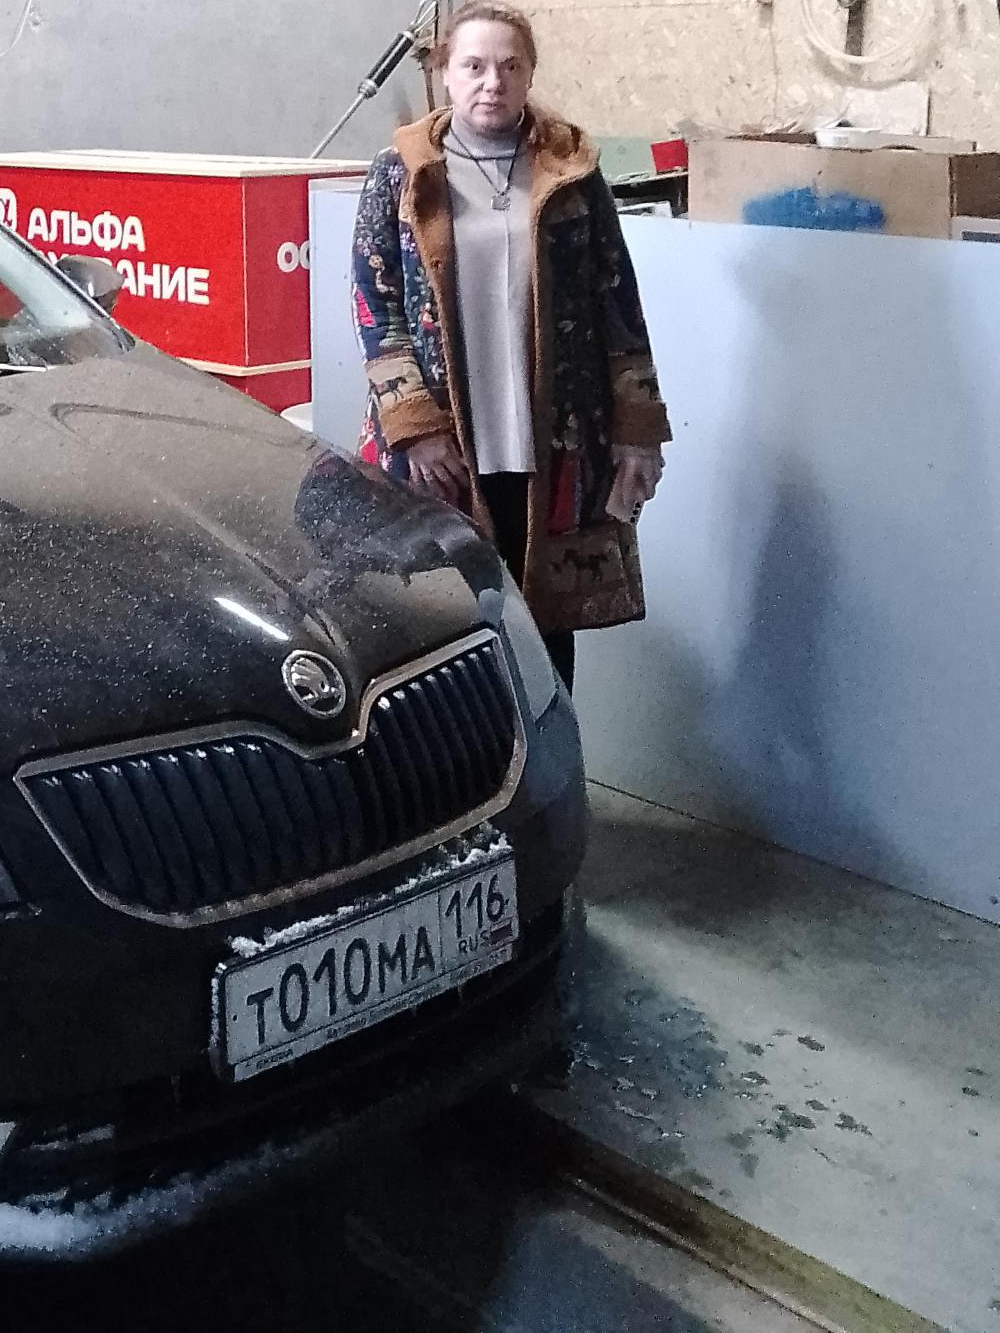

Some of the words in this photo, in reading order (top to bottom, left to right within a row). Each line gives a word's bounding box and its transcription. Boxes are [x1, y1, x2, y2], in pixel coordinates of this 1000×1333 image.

[27, 207, 146, 252] АЛЬФА
[246, 926, 435, 1045] Т010МА
[444, 873, 505, 939] 116
